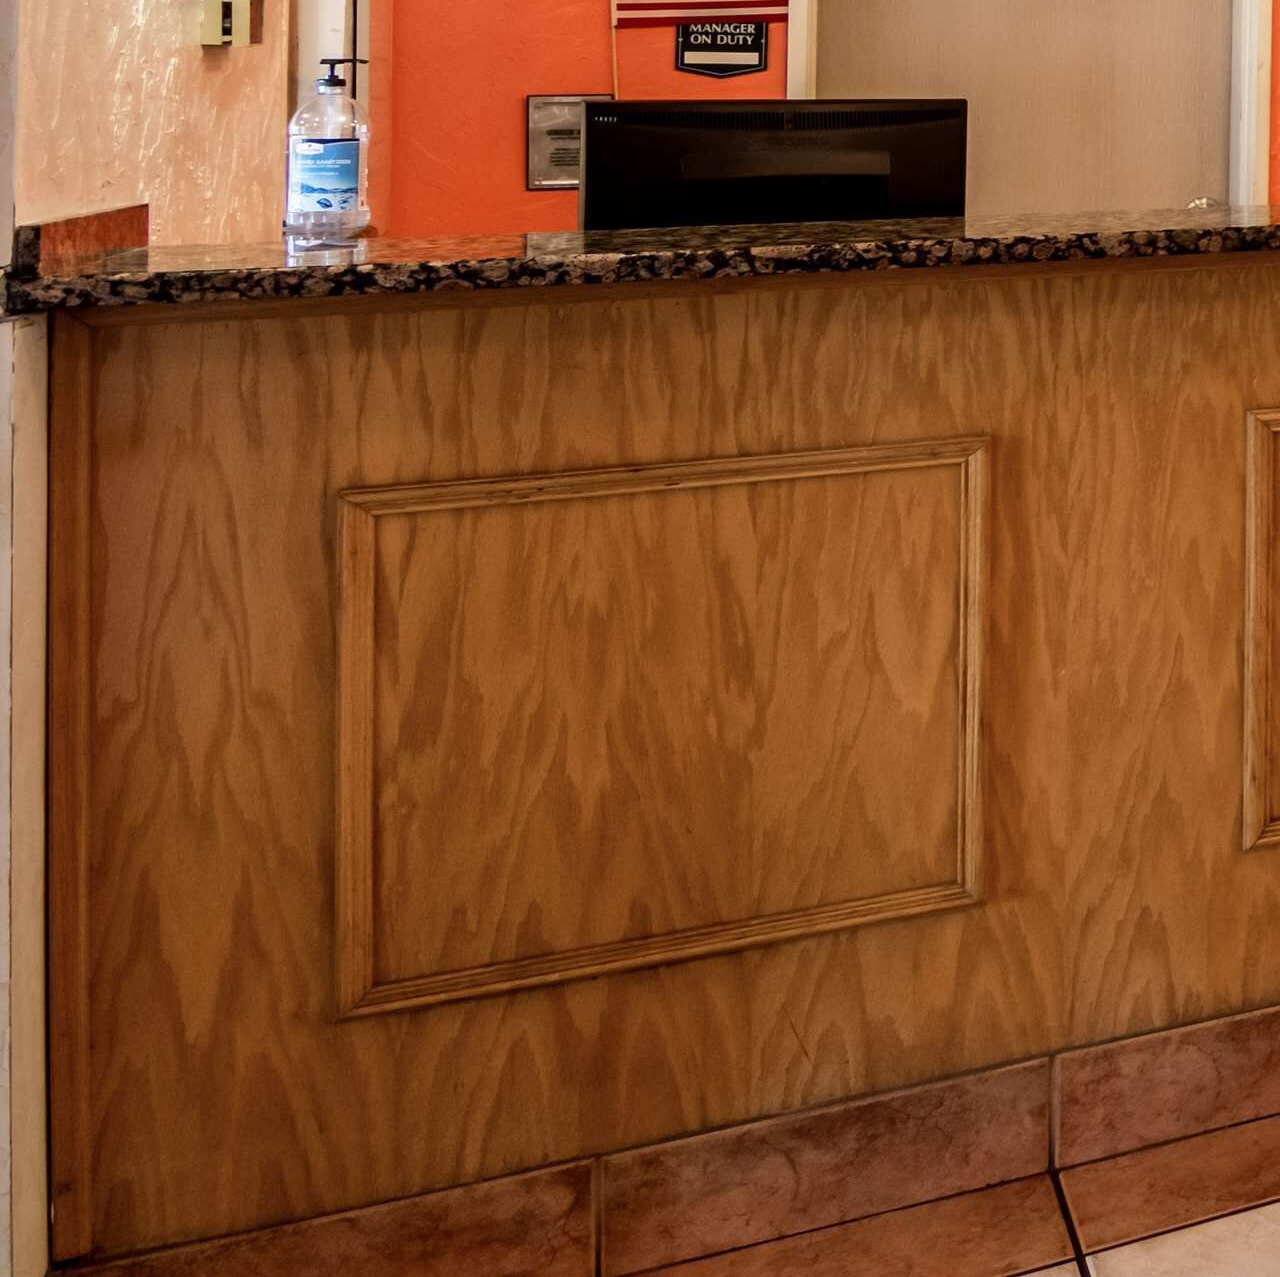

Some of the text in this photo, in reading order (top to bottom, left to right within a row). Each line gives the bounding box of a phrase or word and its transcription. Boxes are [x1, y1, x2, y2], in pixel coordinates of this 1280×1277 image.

[689, 23, 756, 34] MANAGER
[690, 33, 754, 45] ON DUTY
